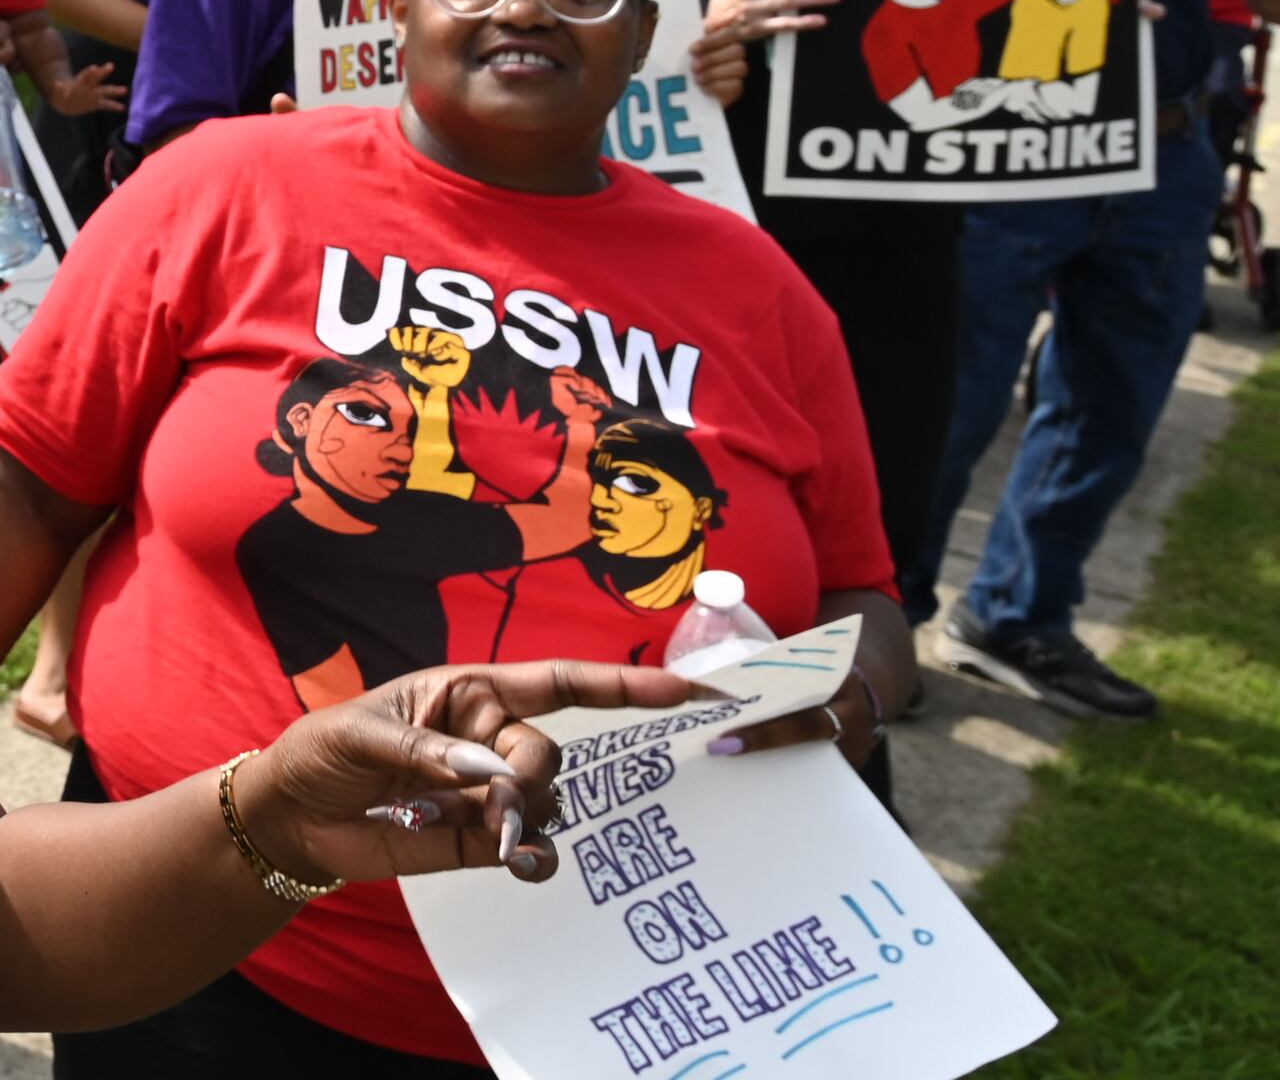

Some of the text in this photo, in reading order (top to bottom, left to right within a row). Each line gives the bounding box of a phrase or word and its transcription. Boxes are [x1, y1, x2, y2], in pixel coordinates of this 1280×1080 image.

[798, 118, 1137, 175] ON STRIKE
[315, 245, 701, 429] USSW
[572, 803, 696, 907] ARE
[623, 880, 729, 966] ON
[590, 972, 730, 1076] THE
[705, 915, 857, 1024] LINE
